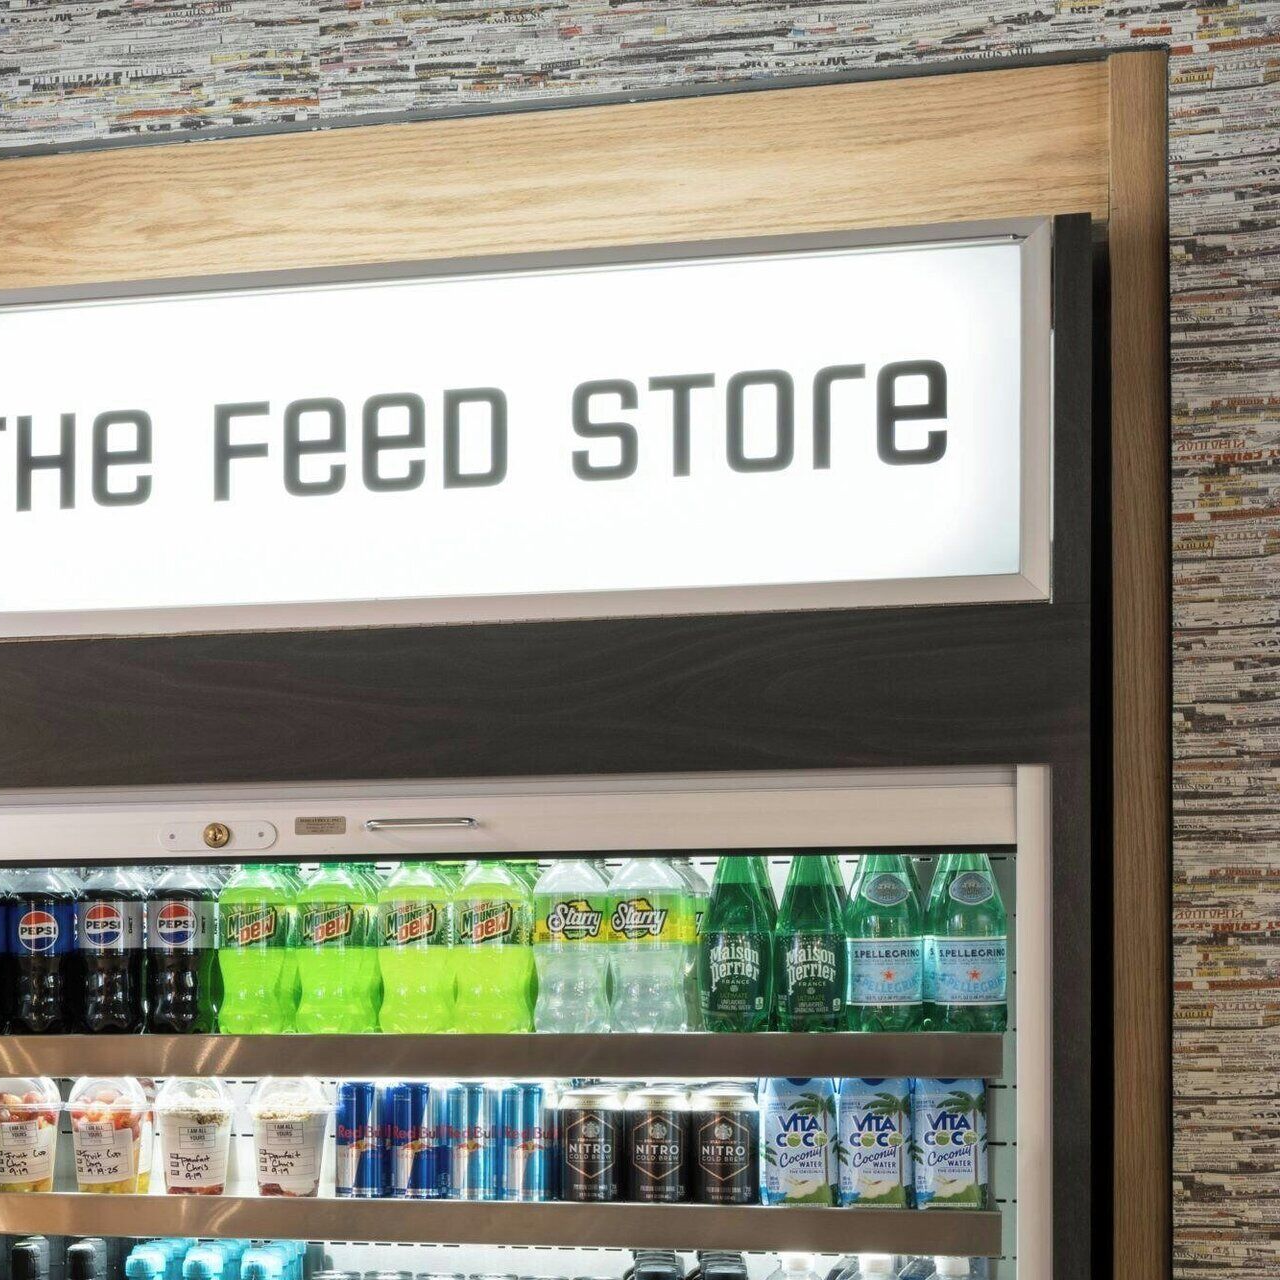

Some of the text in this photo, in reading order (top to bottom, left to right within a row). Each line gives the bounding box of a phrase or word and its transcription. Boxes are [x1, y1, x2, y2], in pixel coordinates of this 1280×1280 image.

[85, 918, 122, 930] PEPSI
[158, 918, 196, 930] PEPSI
[548, 903, 603, 936] Starry
[613, 901, 667, 936] Starry
[20, 925, 57, 936] PEPSI
[710, 943, 759, 965] Maison
[786, 945, 835, 967] Maison
[778, 1113, 821, 1132] VITA
[852, 1113, 896, 1132] VITA
[926, 1111, 971, 1130] VITA
[569, 1144, 612, 1154] NITRO
[636, 1145, 679, 1155] NITRO
[702, 1146, 745, 1156] NITRO
[780, 1146, 822, 1168] Coconut
[853, 1145, 896, 1167] Coconut
[928, 1144, 971, 1166] Coconut
